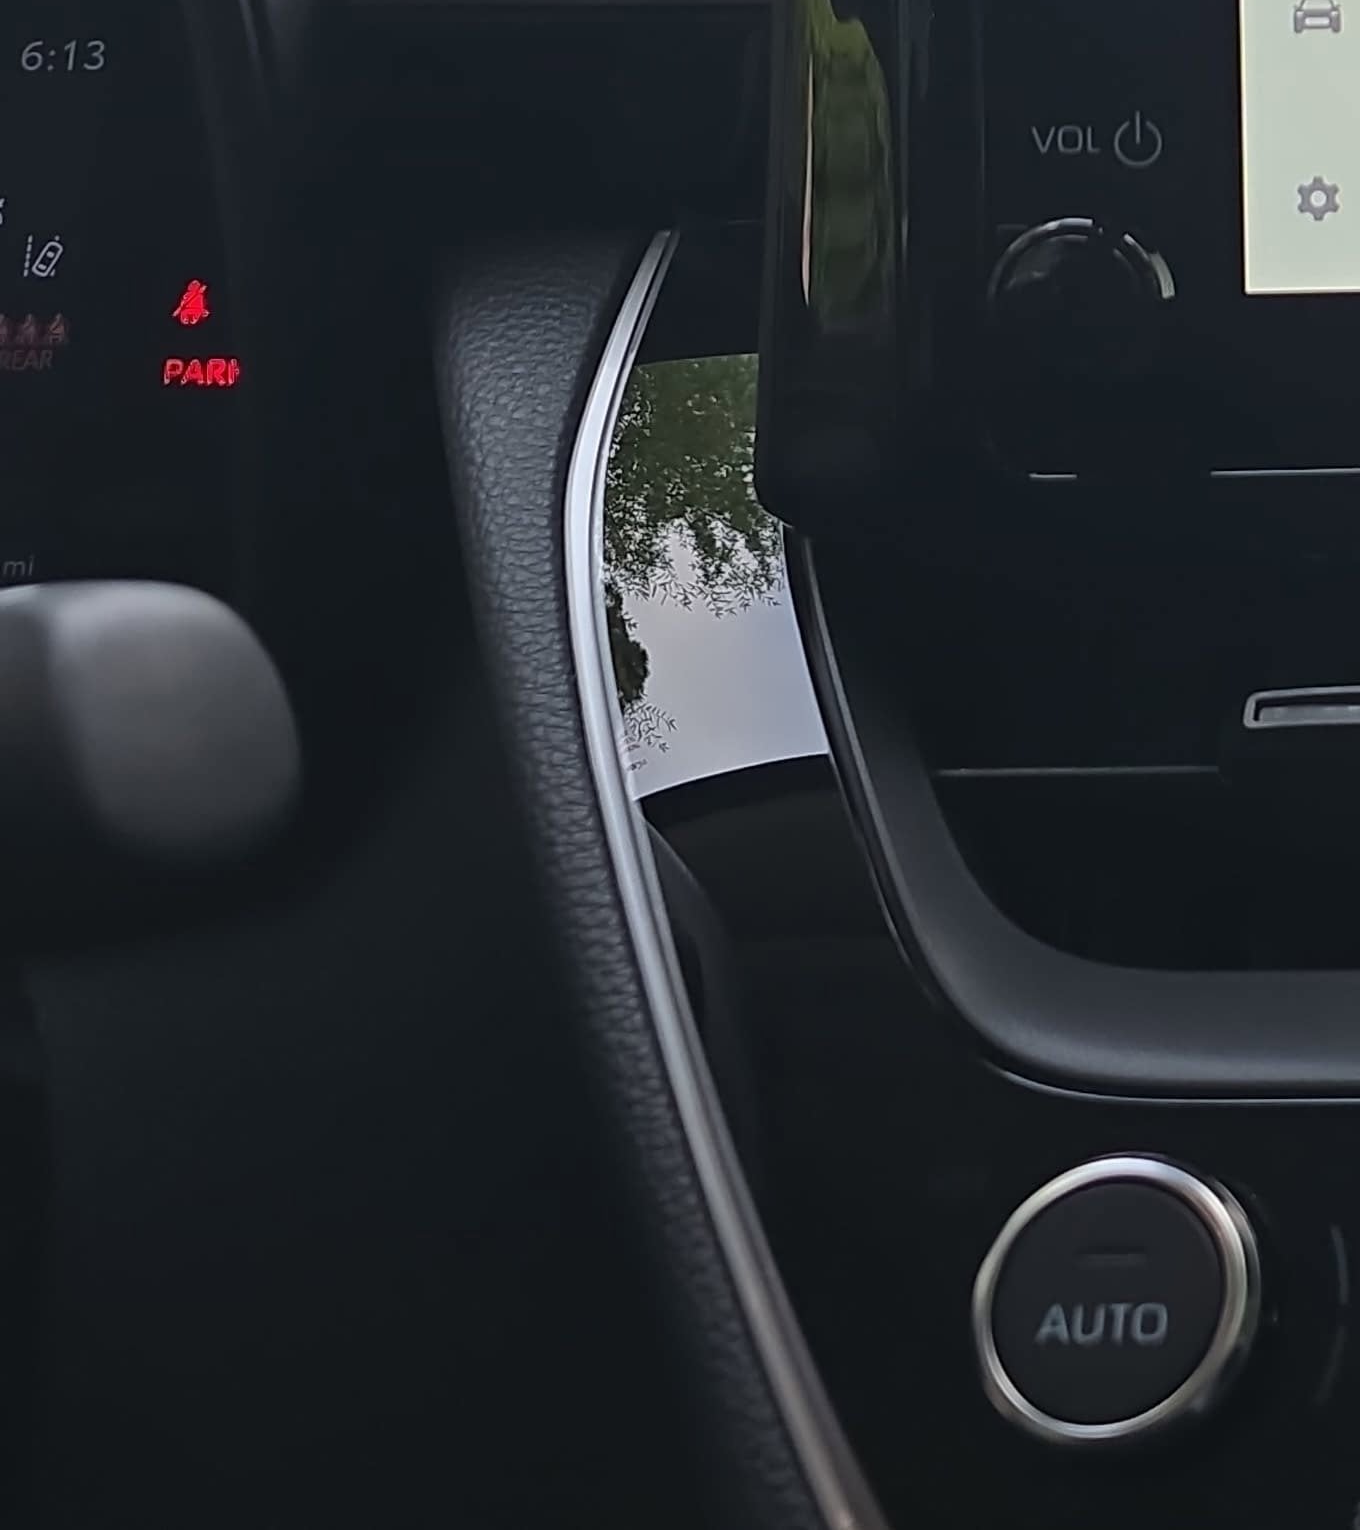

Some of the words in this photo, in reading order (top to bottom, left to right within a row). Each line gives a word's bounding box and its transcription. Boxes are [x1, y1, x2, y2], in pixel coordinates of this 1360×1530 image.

[21, 40, 105, 72] 6:13
[1031, 125, 1099, 154] VOL
[1036, 1302, 1168, 1344] AUTO
